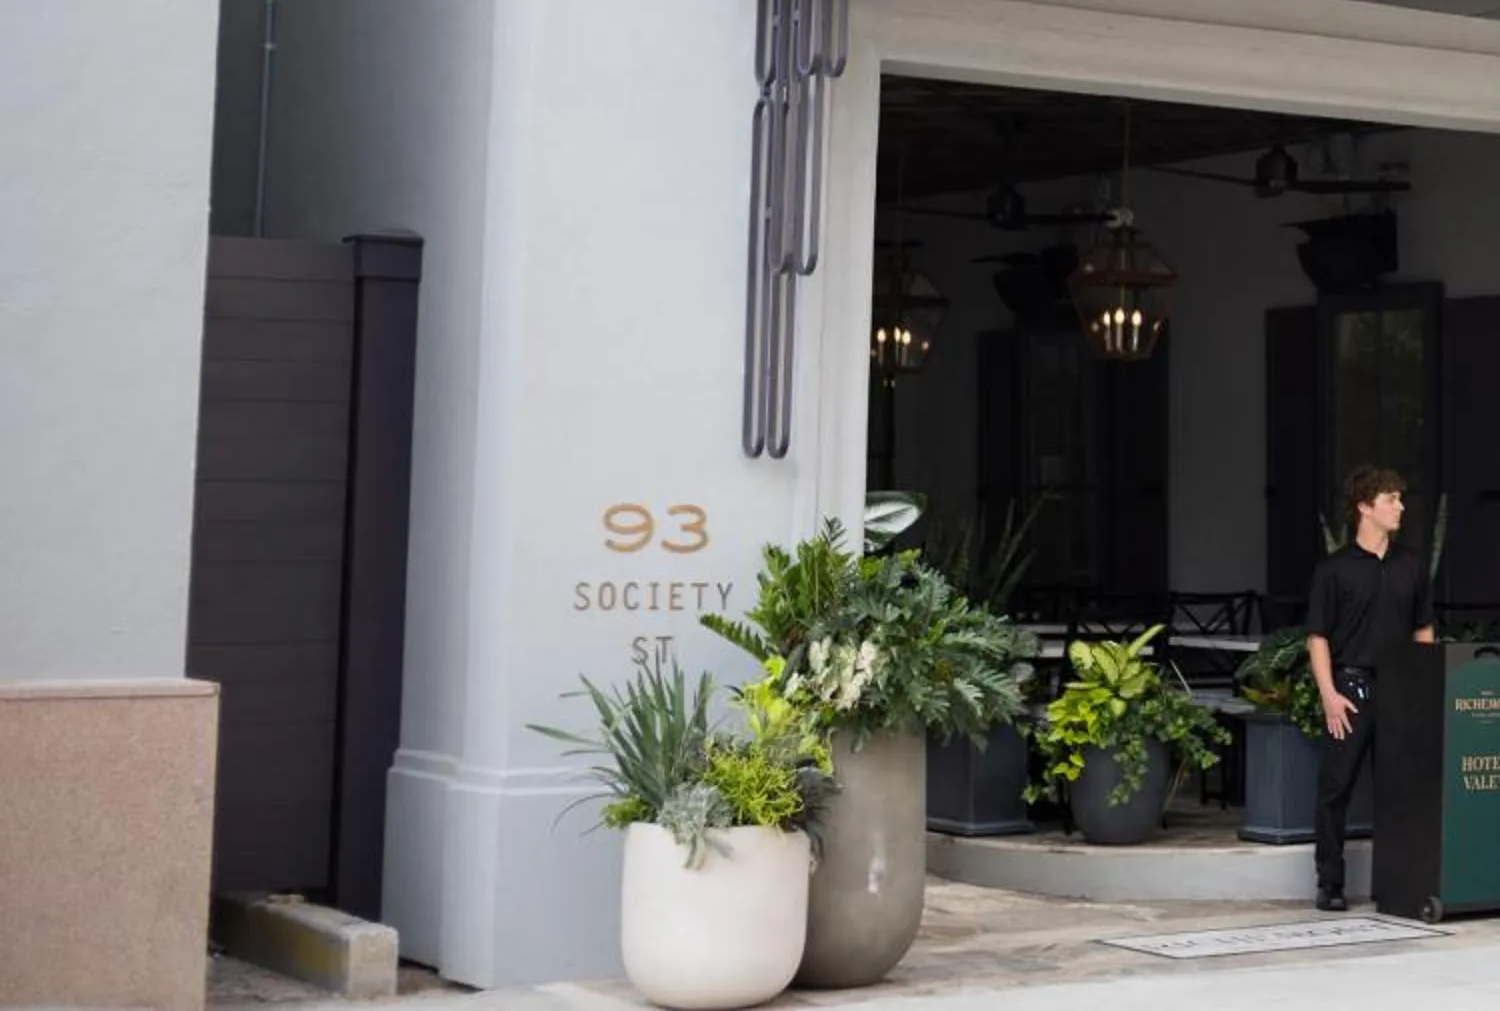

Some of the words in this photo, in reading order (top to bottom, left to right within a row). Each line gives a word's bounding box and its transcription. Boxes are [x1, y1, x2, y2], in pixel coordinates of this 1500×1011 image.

[603, 503, 709, 554] 93
[573, 582, 734, 611] SOCIETY
[632, 635, 674, 665] ST
